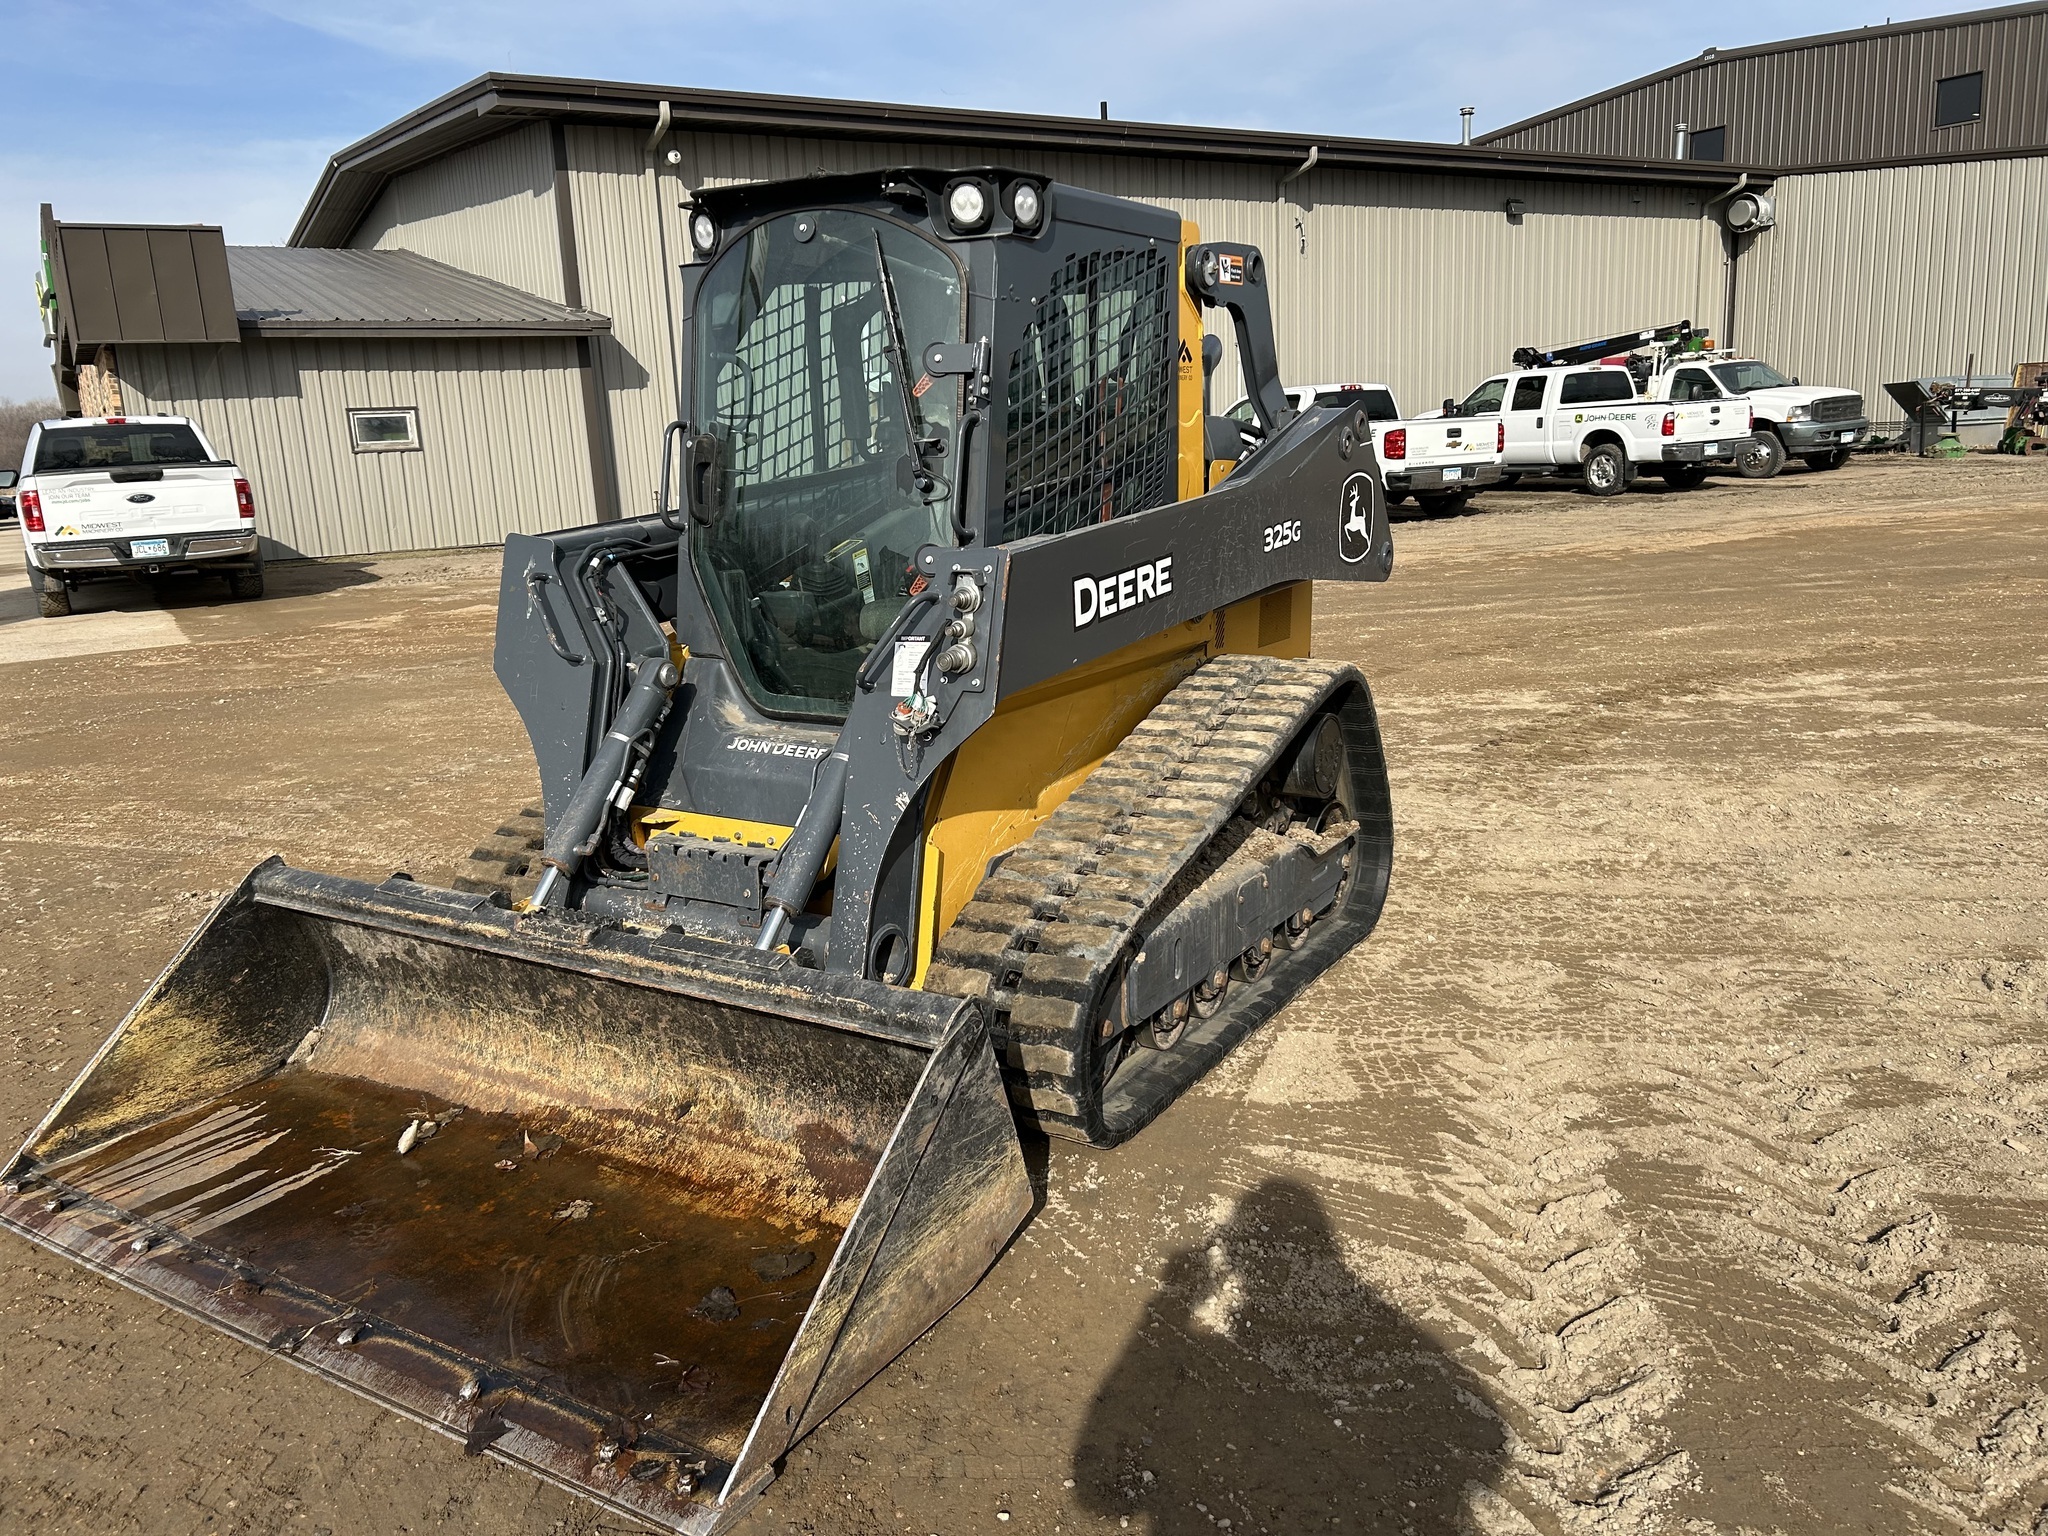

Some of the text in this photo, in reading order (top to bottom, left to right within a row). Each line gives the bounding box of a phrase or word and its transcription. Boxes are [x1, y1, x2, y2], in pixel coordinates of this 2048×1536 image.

[1584, 413, 1637, 422] JOHN DEERE
[81, 521, 122, 531] MIDWEST
[1264, 520, 1301, 552] 325G
[1073, 556, 1173, 628] DEERE
[727, 736, 772, 755] JOHN
